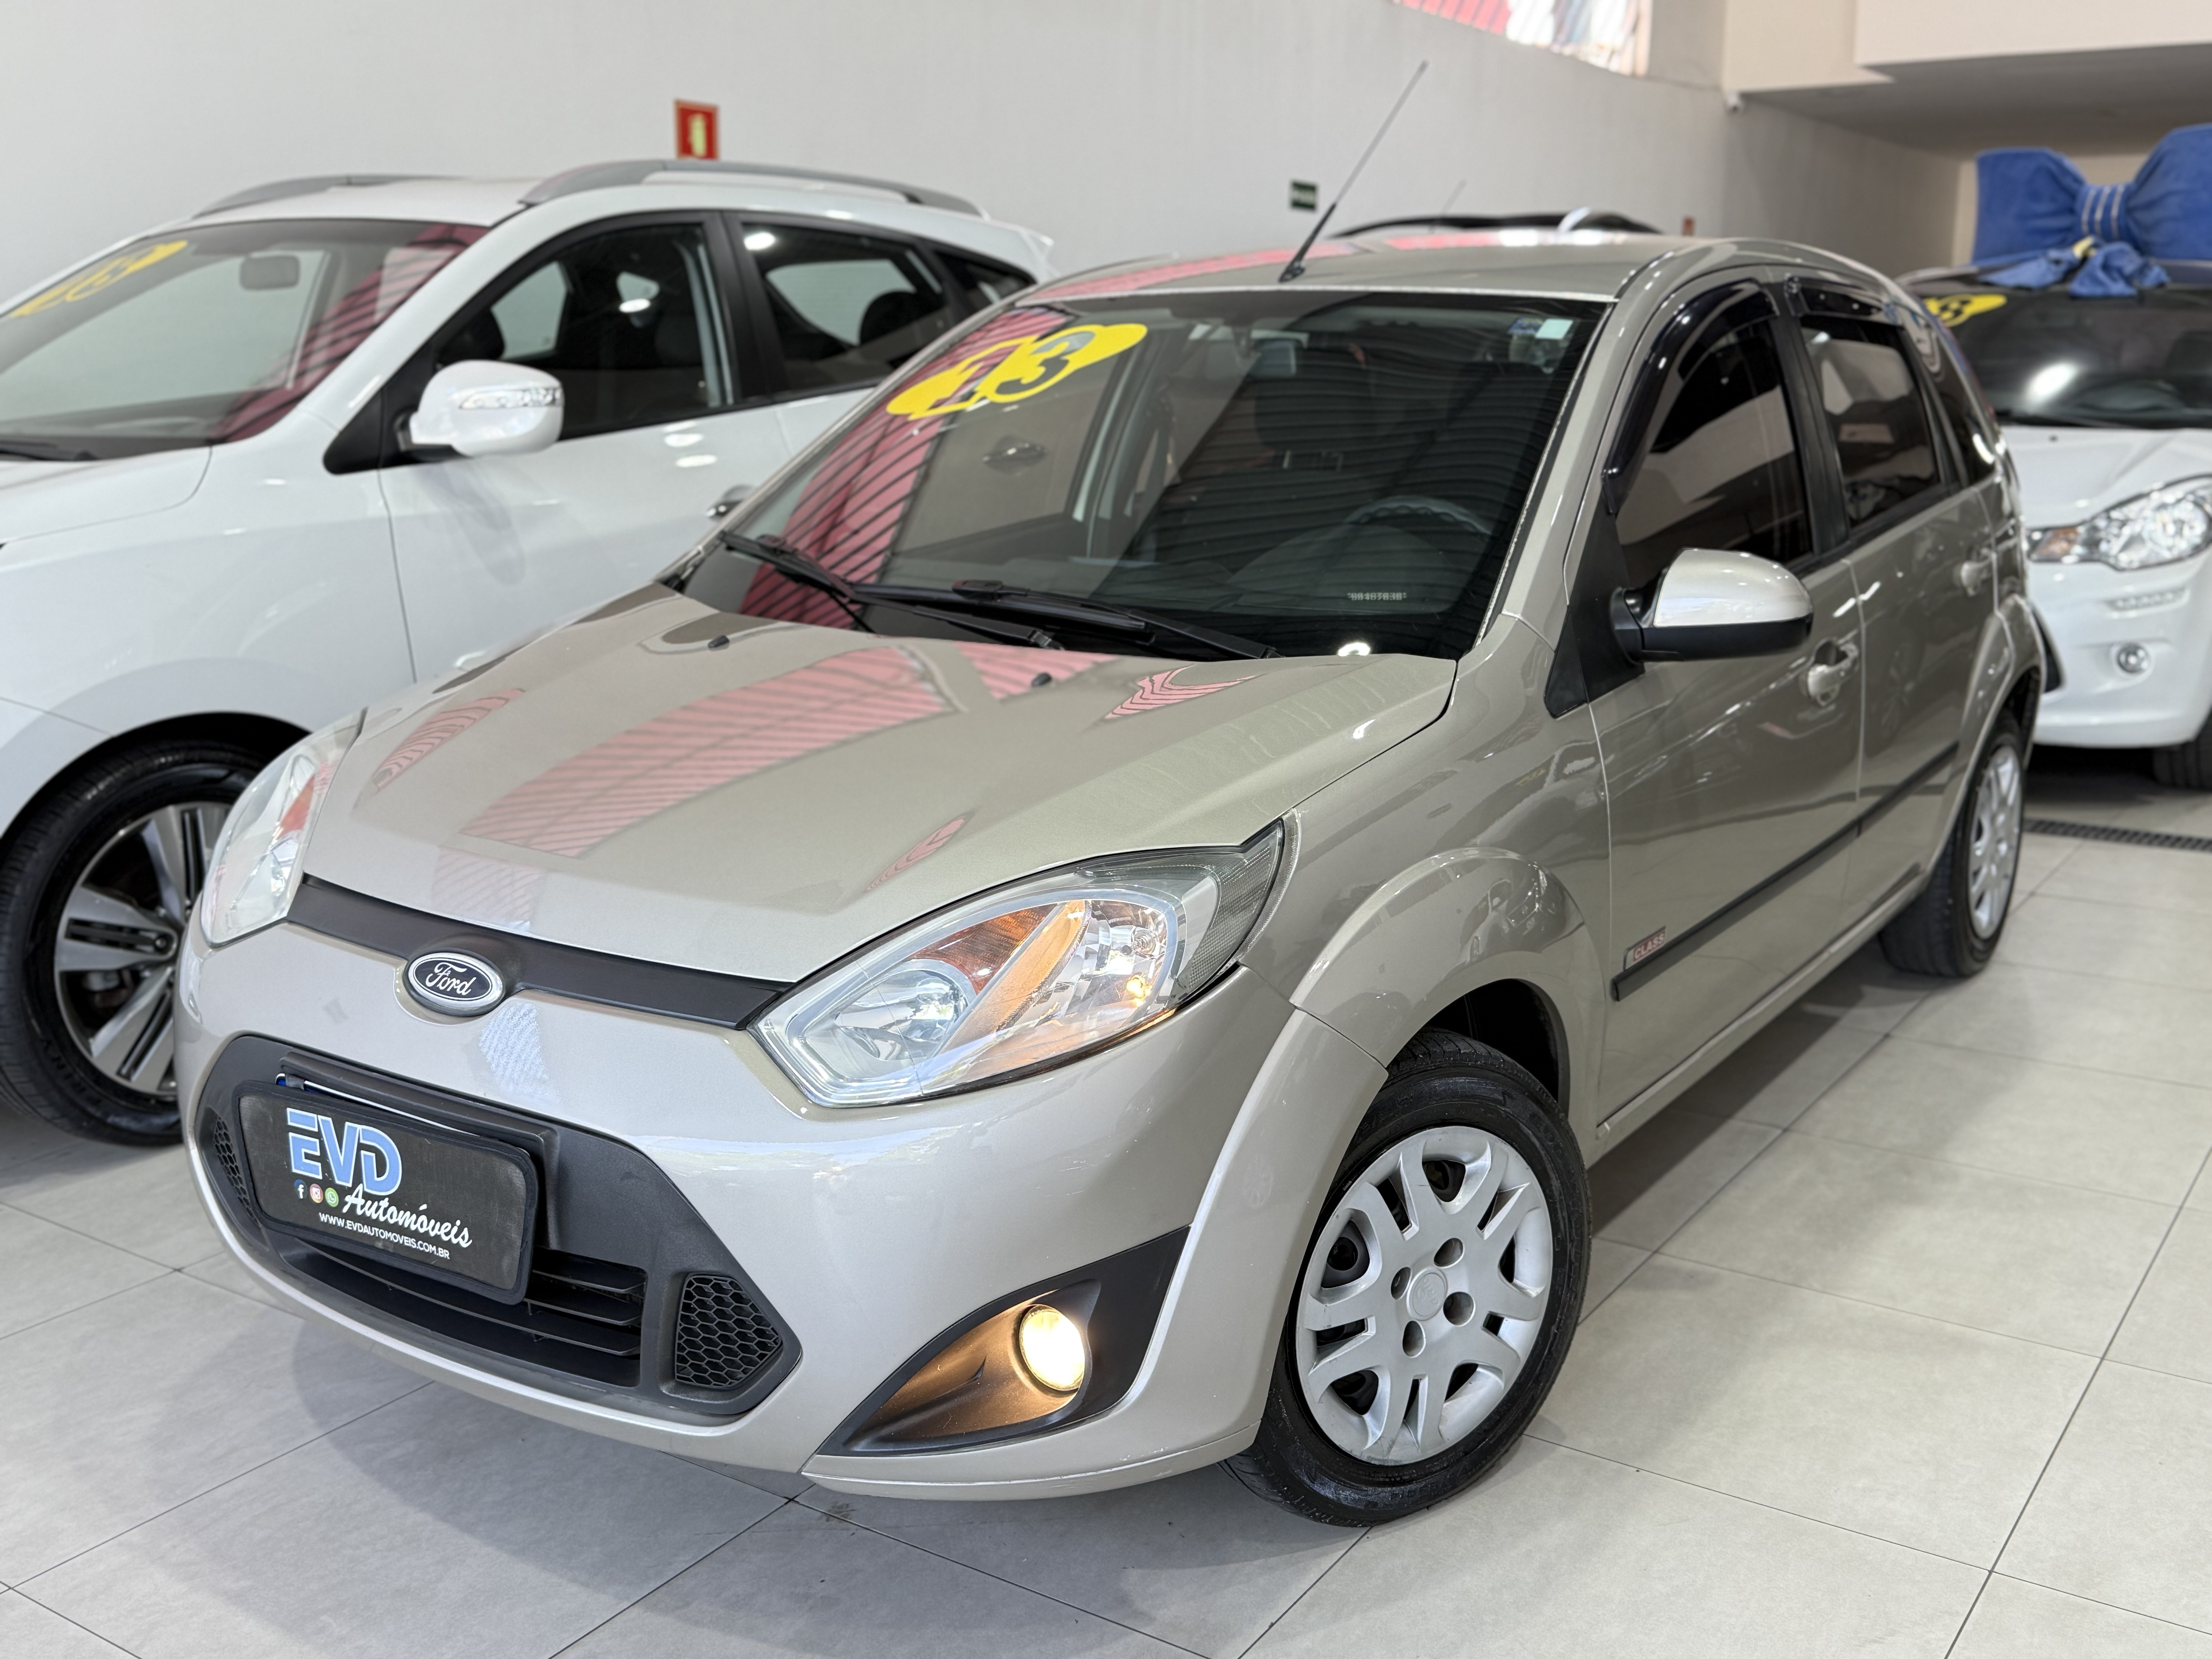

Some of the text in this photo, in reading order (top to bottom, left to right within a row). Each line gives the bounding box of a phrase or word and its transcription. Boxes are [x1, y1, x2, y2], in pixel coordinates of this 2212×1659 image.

[1634, 933, 1664, 959] CLASS
[426, 962, 477, 995] Ford
[286, 1107, 402, 1196] EVD
[319, 1212, 450, 1260] WWW.EVDAUTOMOVEIS.COM.BR
[342, 1183, 472, 1248] Automóveis
